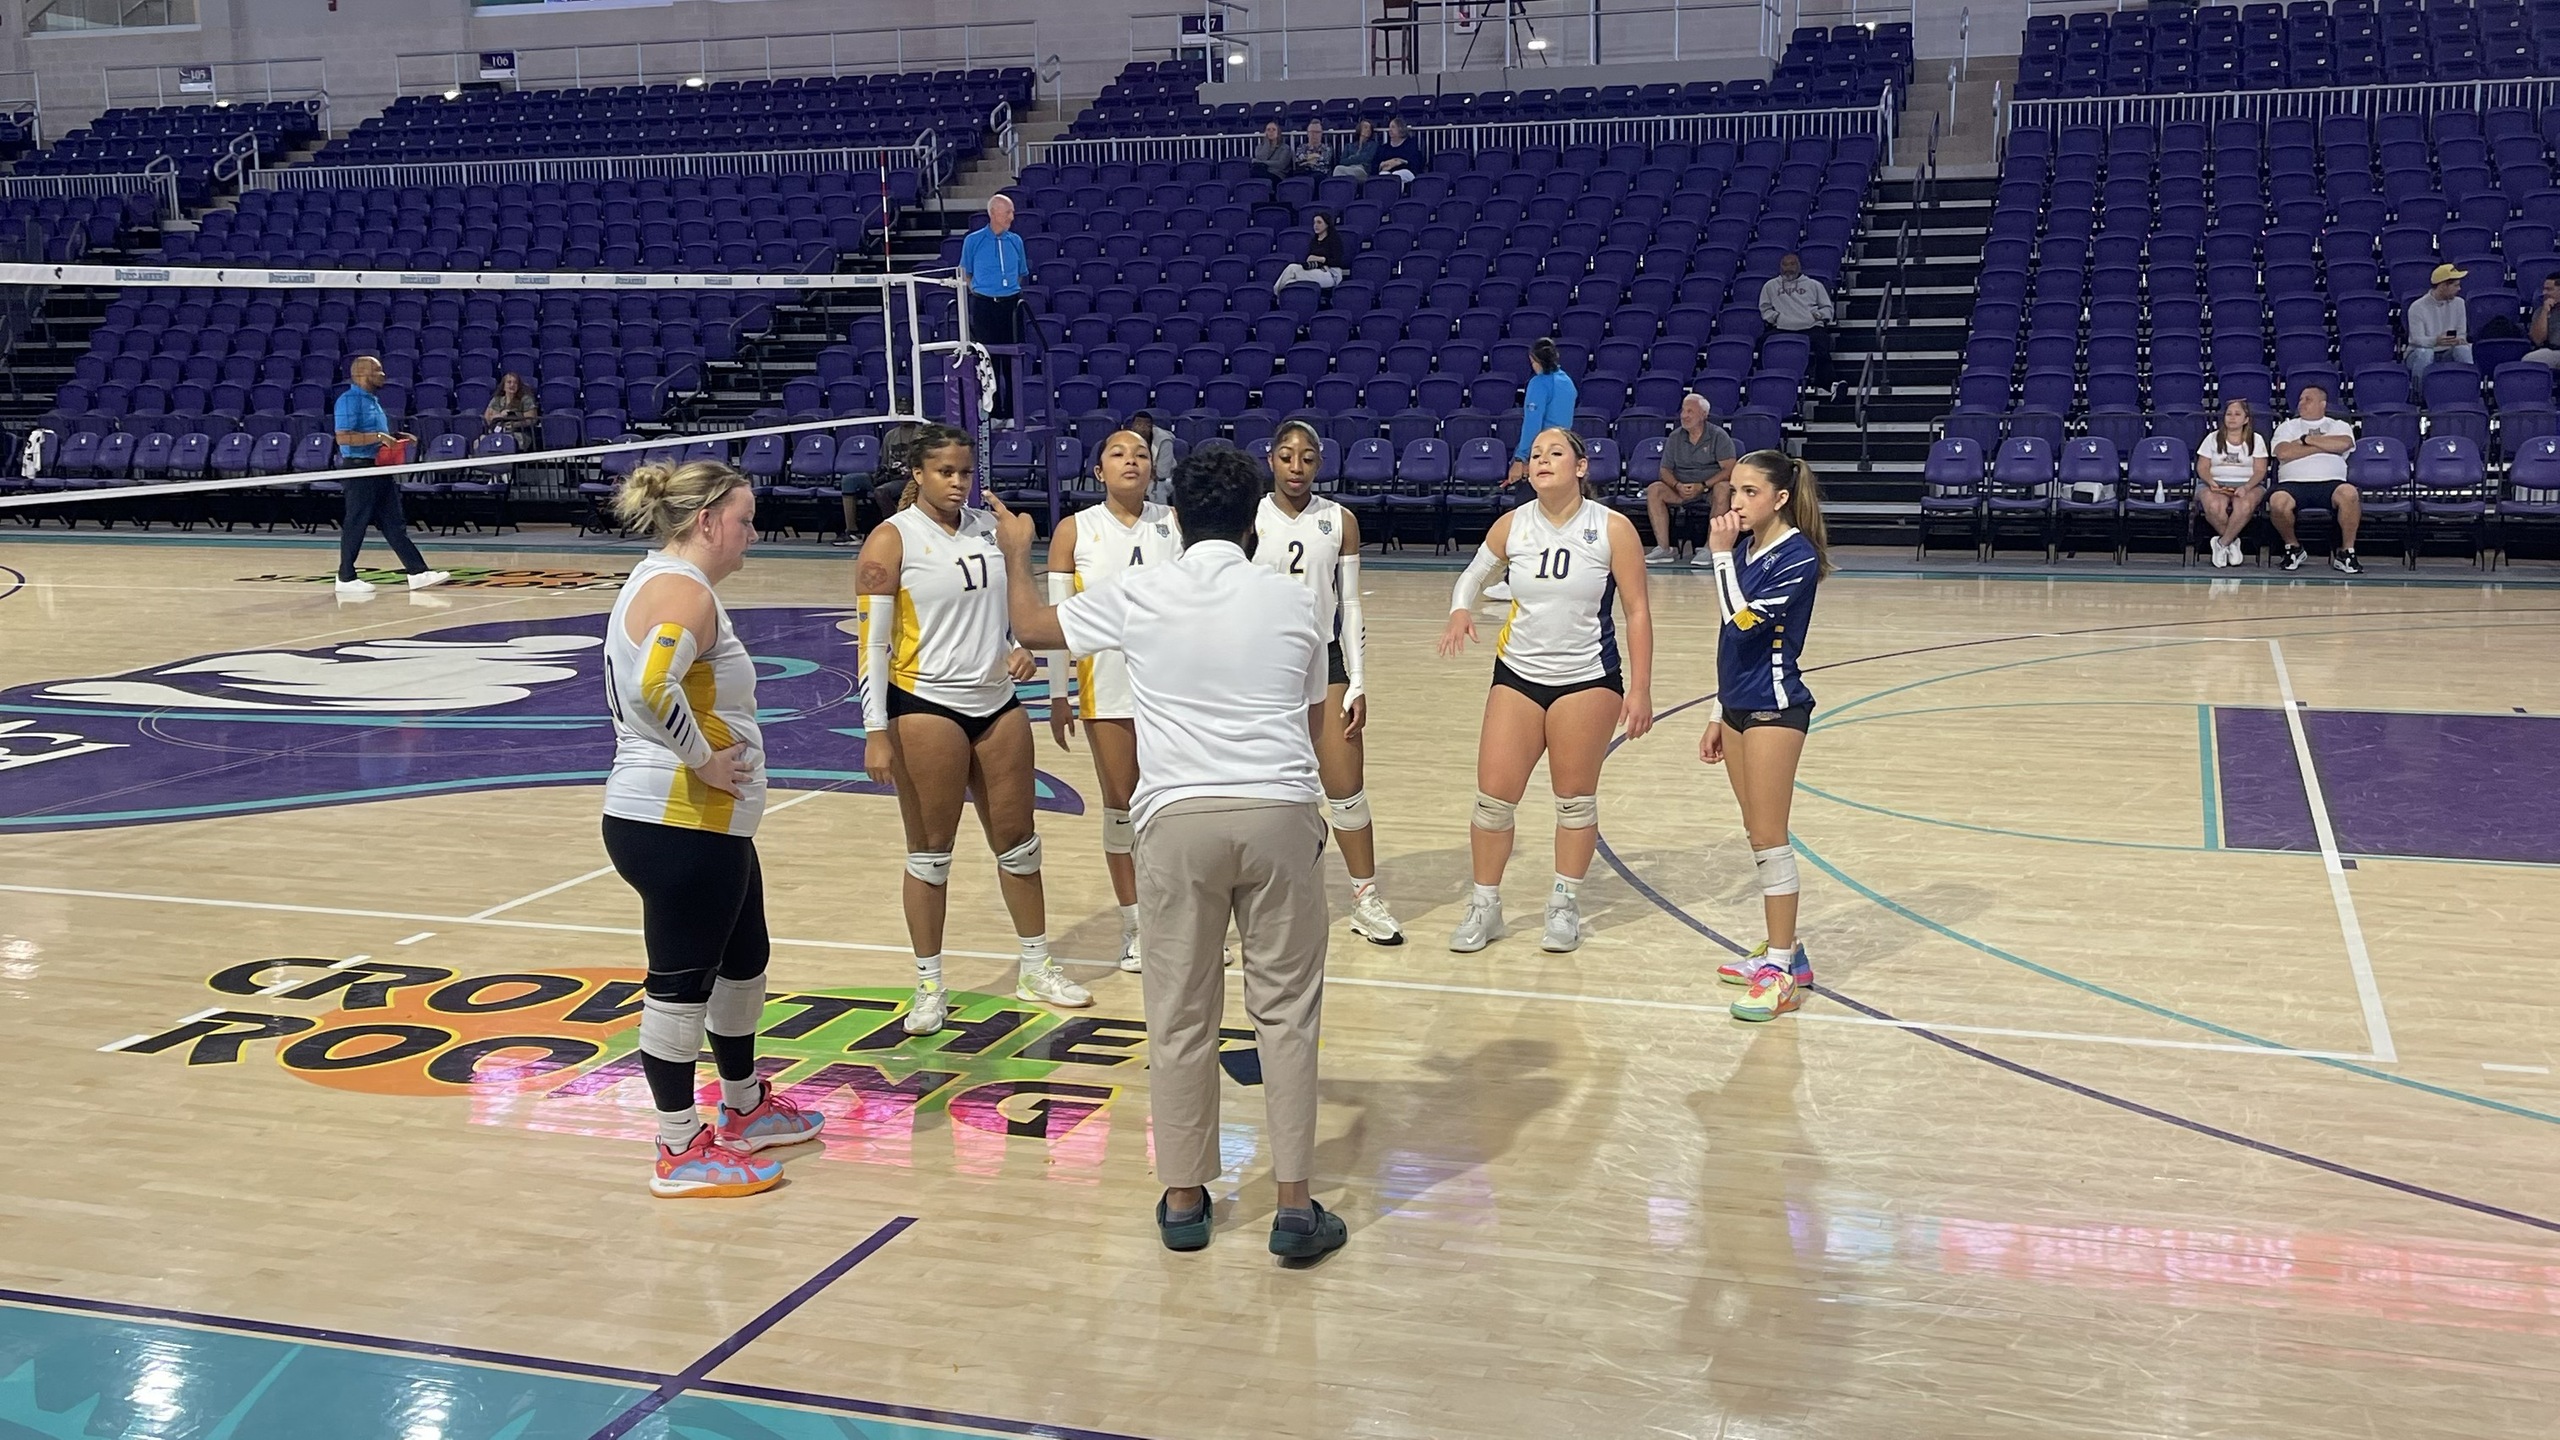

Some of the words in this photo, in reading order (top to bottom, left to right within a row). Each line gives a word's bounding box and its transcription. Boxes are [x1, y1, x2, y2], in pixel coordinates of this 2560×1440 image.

[492, 55, 509, 67] 106
[955, 553, 988, 592] 17
[1288, 540, 1304, 574] 2
[1535, 547, 1571, 580] 10
